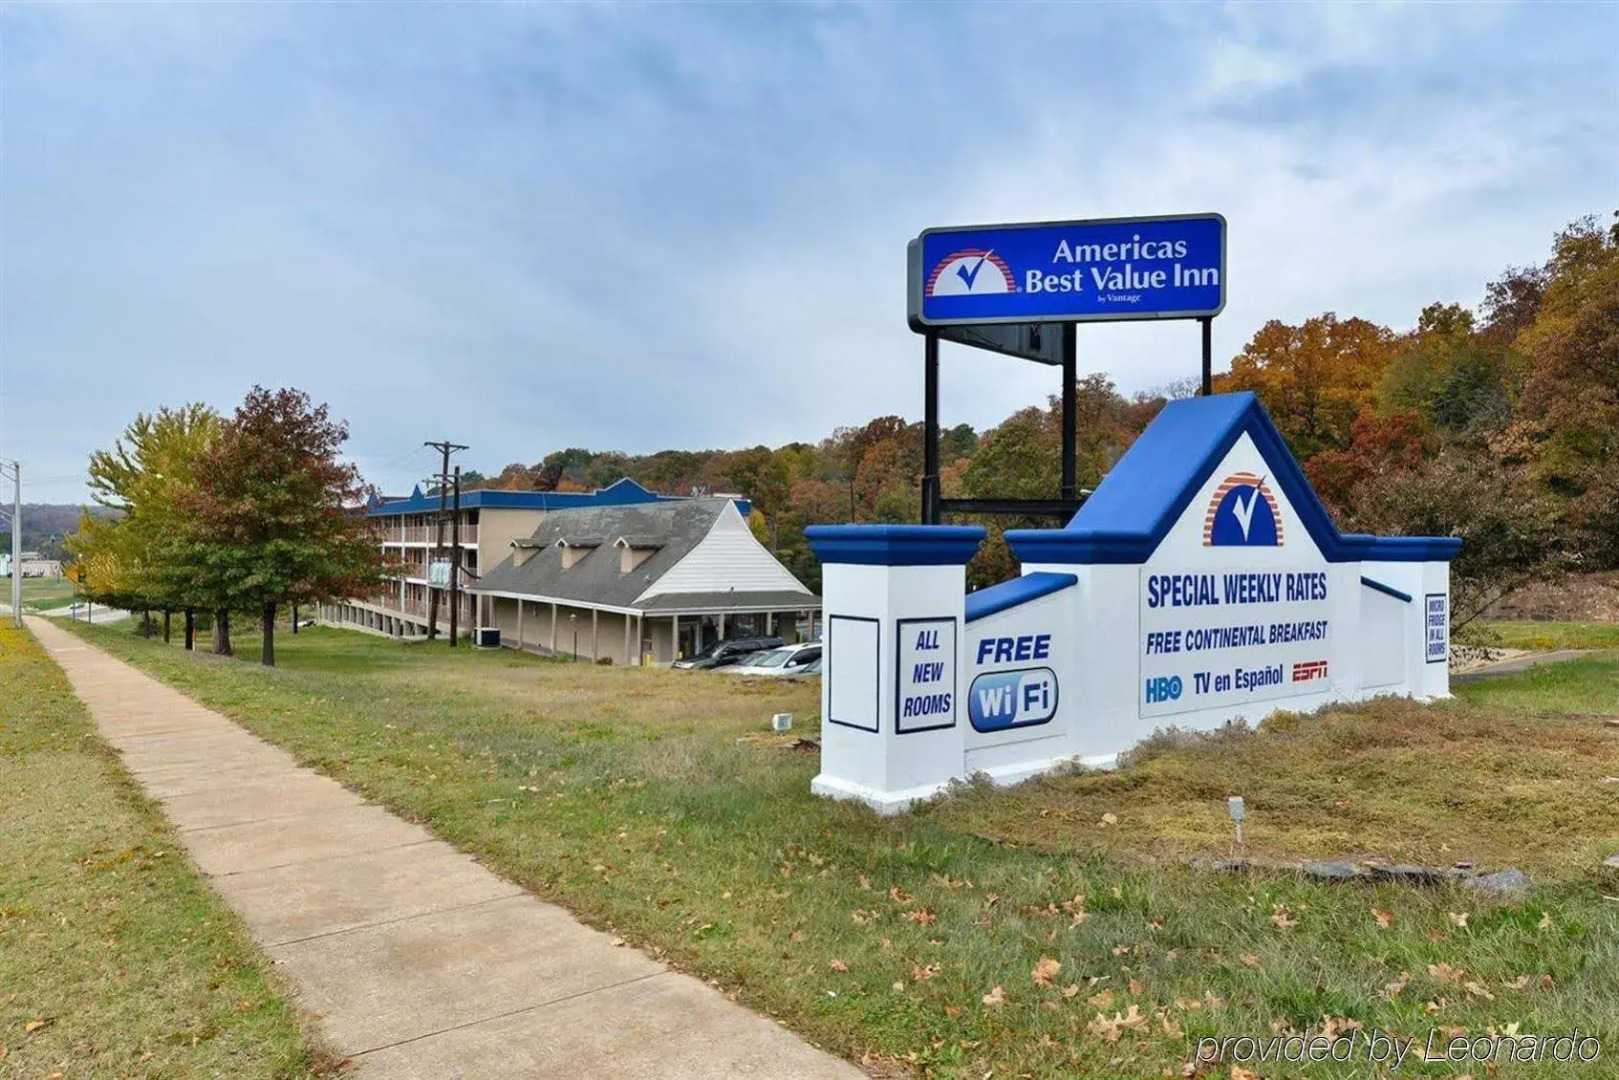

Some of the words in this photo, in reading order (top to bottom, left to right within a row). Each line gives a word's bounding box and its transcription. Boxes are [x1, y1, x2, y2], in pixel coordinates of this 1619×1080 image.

[1053, 234, 1187, 263] Americas
[1026, 269, 1083, 293] Best
[1090, 265, 1167, 290] Value
[1174, 263, 1219, 287] Inn
[1107, 293, 1141, 303] Vantage
[1148, 574, 1219, 608] SPECIAL
[1223, 573, 1282, 604] WEEKLY
[1286, 572, 1327, 601] RATES
[915, 630, 940, 650] ALL
[976, 634, 1051, 665] FREE
[1146, 631, 1181, 654] FREE
[1185, 626, 1266, 650] CONTINENTAL
[1269, 620, 1328, 644] BREAKFAST
[912, 662, 944, 683] NEW
[1193, 673, 1212, 695] TV
[1215, 676, 1231, 692] en
[1235, 664, 1283, 695] Español
[1292, 660, 1328, 682] ESPN
[1146, 675, 1182, 703] HBO
[904, 693, 952, 717] ROOMS
